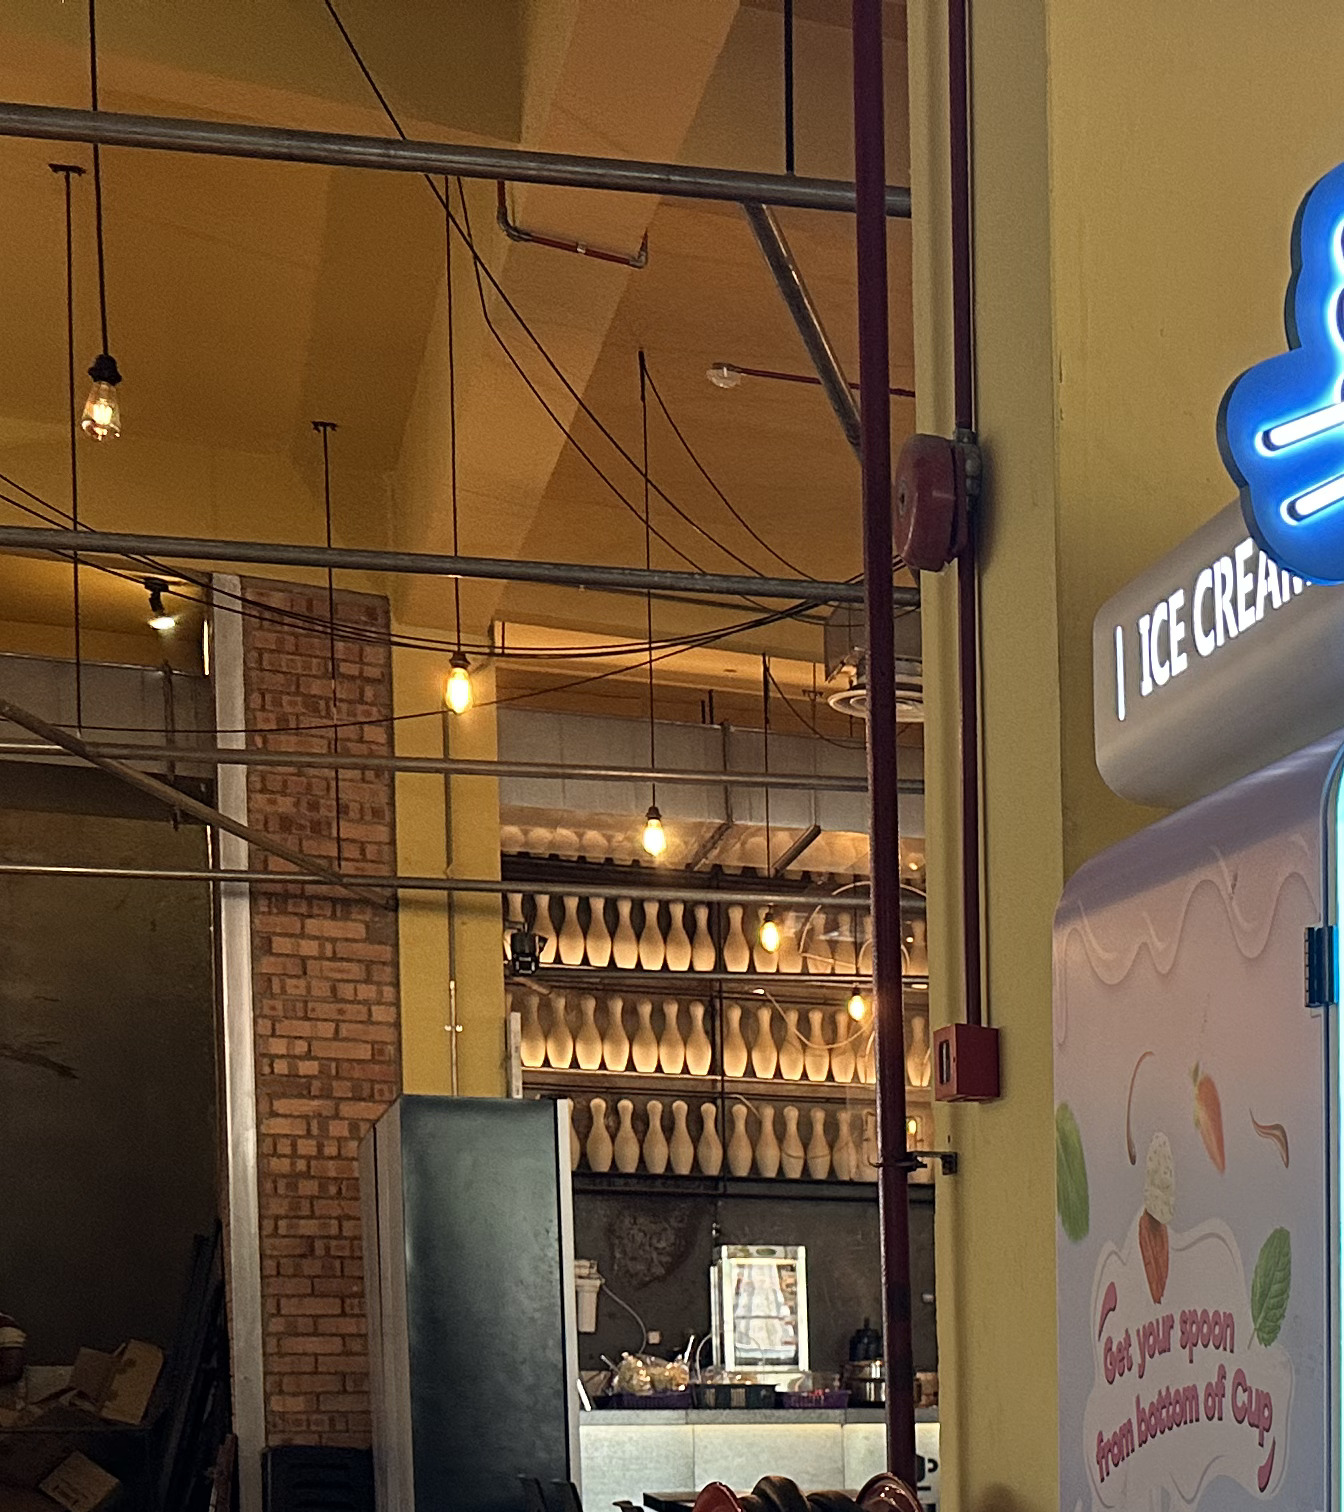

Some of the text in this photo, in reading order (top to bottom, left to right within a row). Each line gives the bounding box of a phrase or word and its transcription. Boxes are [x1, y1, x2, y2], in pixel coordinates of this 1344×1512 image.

[1138, 588, 1188, 696] ICE
[1103, 1308, 1235, 1385] Get your spoon
[1096, 1363, 1273, 1483] from bottom of Cup
